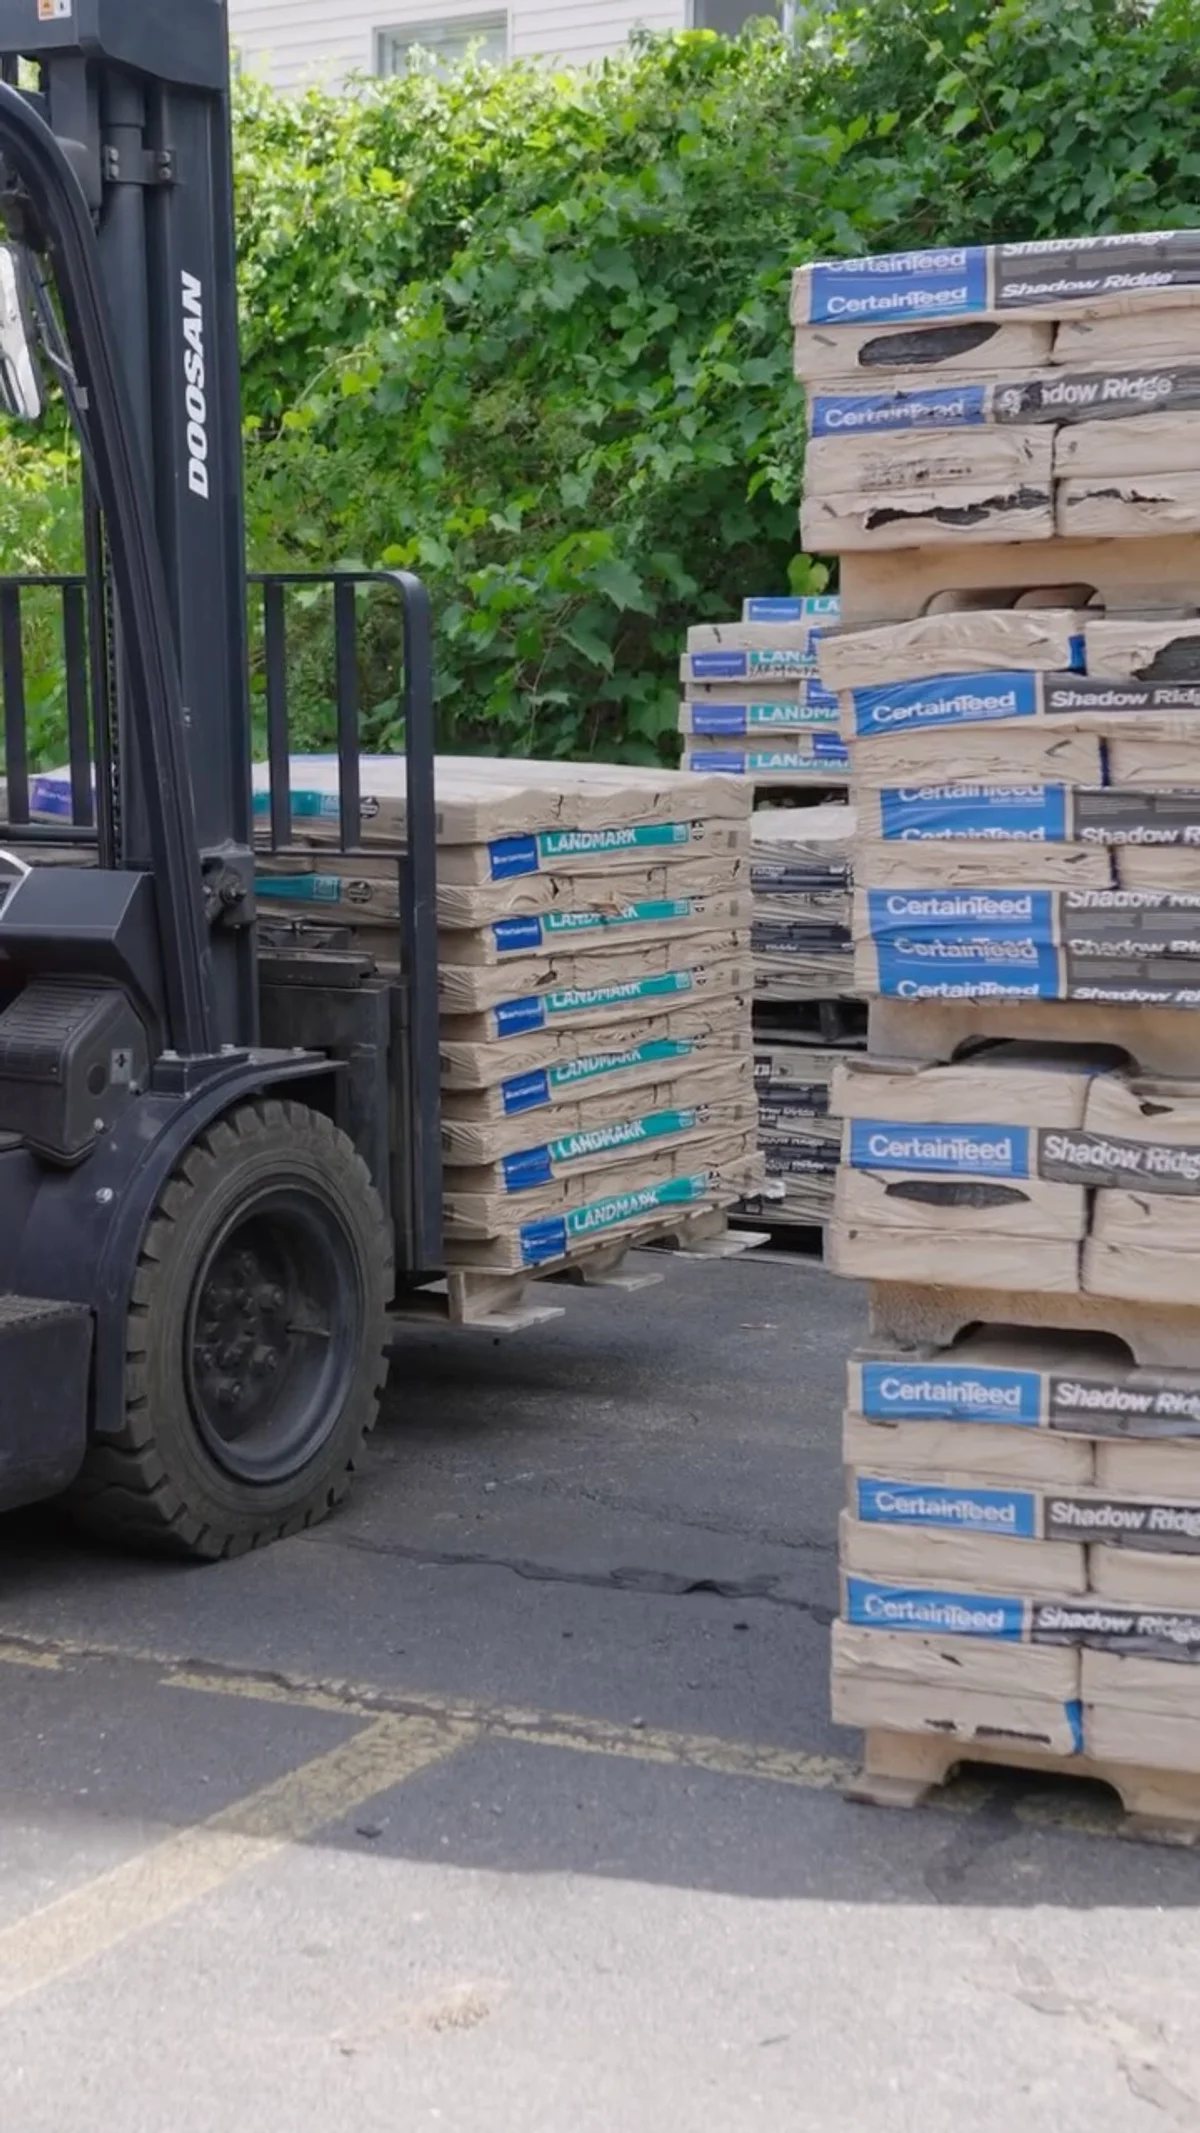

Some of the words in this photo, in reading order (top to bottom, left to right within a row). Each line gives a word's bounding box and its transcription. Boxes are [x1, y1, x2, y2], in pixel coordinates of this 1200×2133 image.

[827, 286, 967, 314] CertainTeed
[1001, 279, 1100, 299] Shadow
[1102, 271, 1174, 288] Ridge
[181, 269, 209, 500] DOOSAN
[1102, 377, 1174, 402] Ridge
[872, 691, 1016, 723] CertainTeed
[1050, 690, 1149, 708] Shadow
[546, 829, 638, 853] LANDMARK
[1080, 826, 1179, 845] Shadow
[887, 896, 1032, 916] CertainTeed
[551, 982, 642, 1008] LANDMARK
[896, 980, 1039, 999] CertainTeed
[558, 1120, 647, 1158] LANDMARK
[868, 1134, 1012, 1161] CertainTeed
[1044, 1135, 1141, 1169] Shadow
[573, 1190, 660, 1231] LANDMARK
[879, 1377, 1022, 1406] CertainTeed
[1056, 1382, 1153, 1412] Shadow
[875, 1491, 1016, 1524] CertainTeed
[1050, 1501, 1145, 1528] Shadow
[863, 1593, 1005, 1630] CertainTeed
[1037, 1605, 1134, 1634] Shadow
